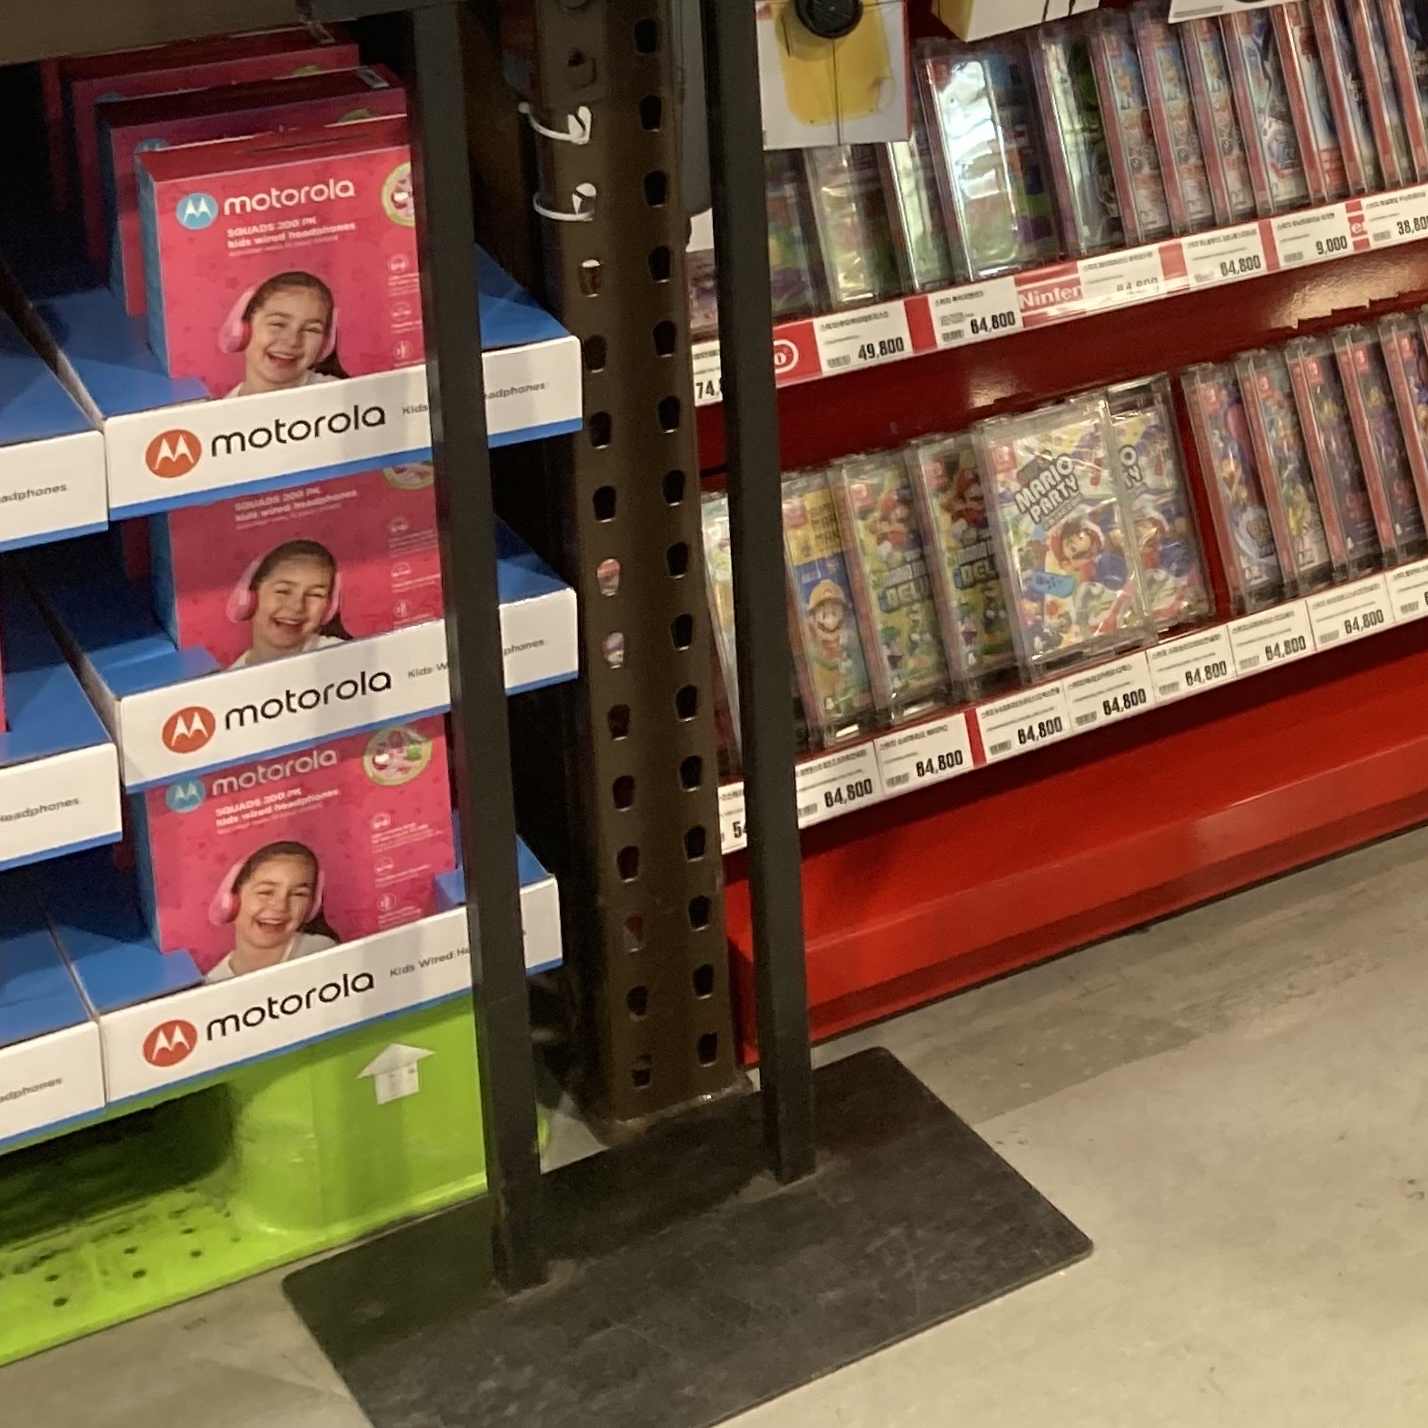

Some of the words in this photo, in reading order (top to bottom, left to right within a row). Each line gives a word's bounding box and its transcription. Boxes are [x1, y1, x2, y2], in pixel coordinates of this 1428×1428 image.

[224, 178, 355, 217] motorola
[227, 222, 275, 239] SQUADS
[227, 236, 252, 250] kids
[254, 231, 286, 247] wired
[288, 222, 357, 243] headphones
[970, 311, 1018, 336] 64,800
[857, 335, 906, 362] 49,800
[210, 402, 388, 459] motorola
[402, 403, 430, 416] Kids
[1013, 453, 1075, 514] MARIO
[1027, 472, 1080, 525] PARTY
[225, 668, 392, 732] motorola
[408, 665, 434, 679] Kids
[212, 749, 339, 798] motorola
[215, 798, 261, 817] SQUADS
[274, 789, 340, 812] headphones
[206, 969, 375, 1041] motorola
[389, 963, 416, 978] Kids
[418, 949, 453, 969] Wired
